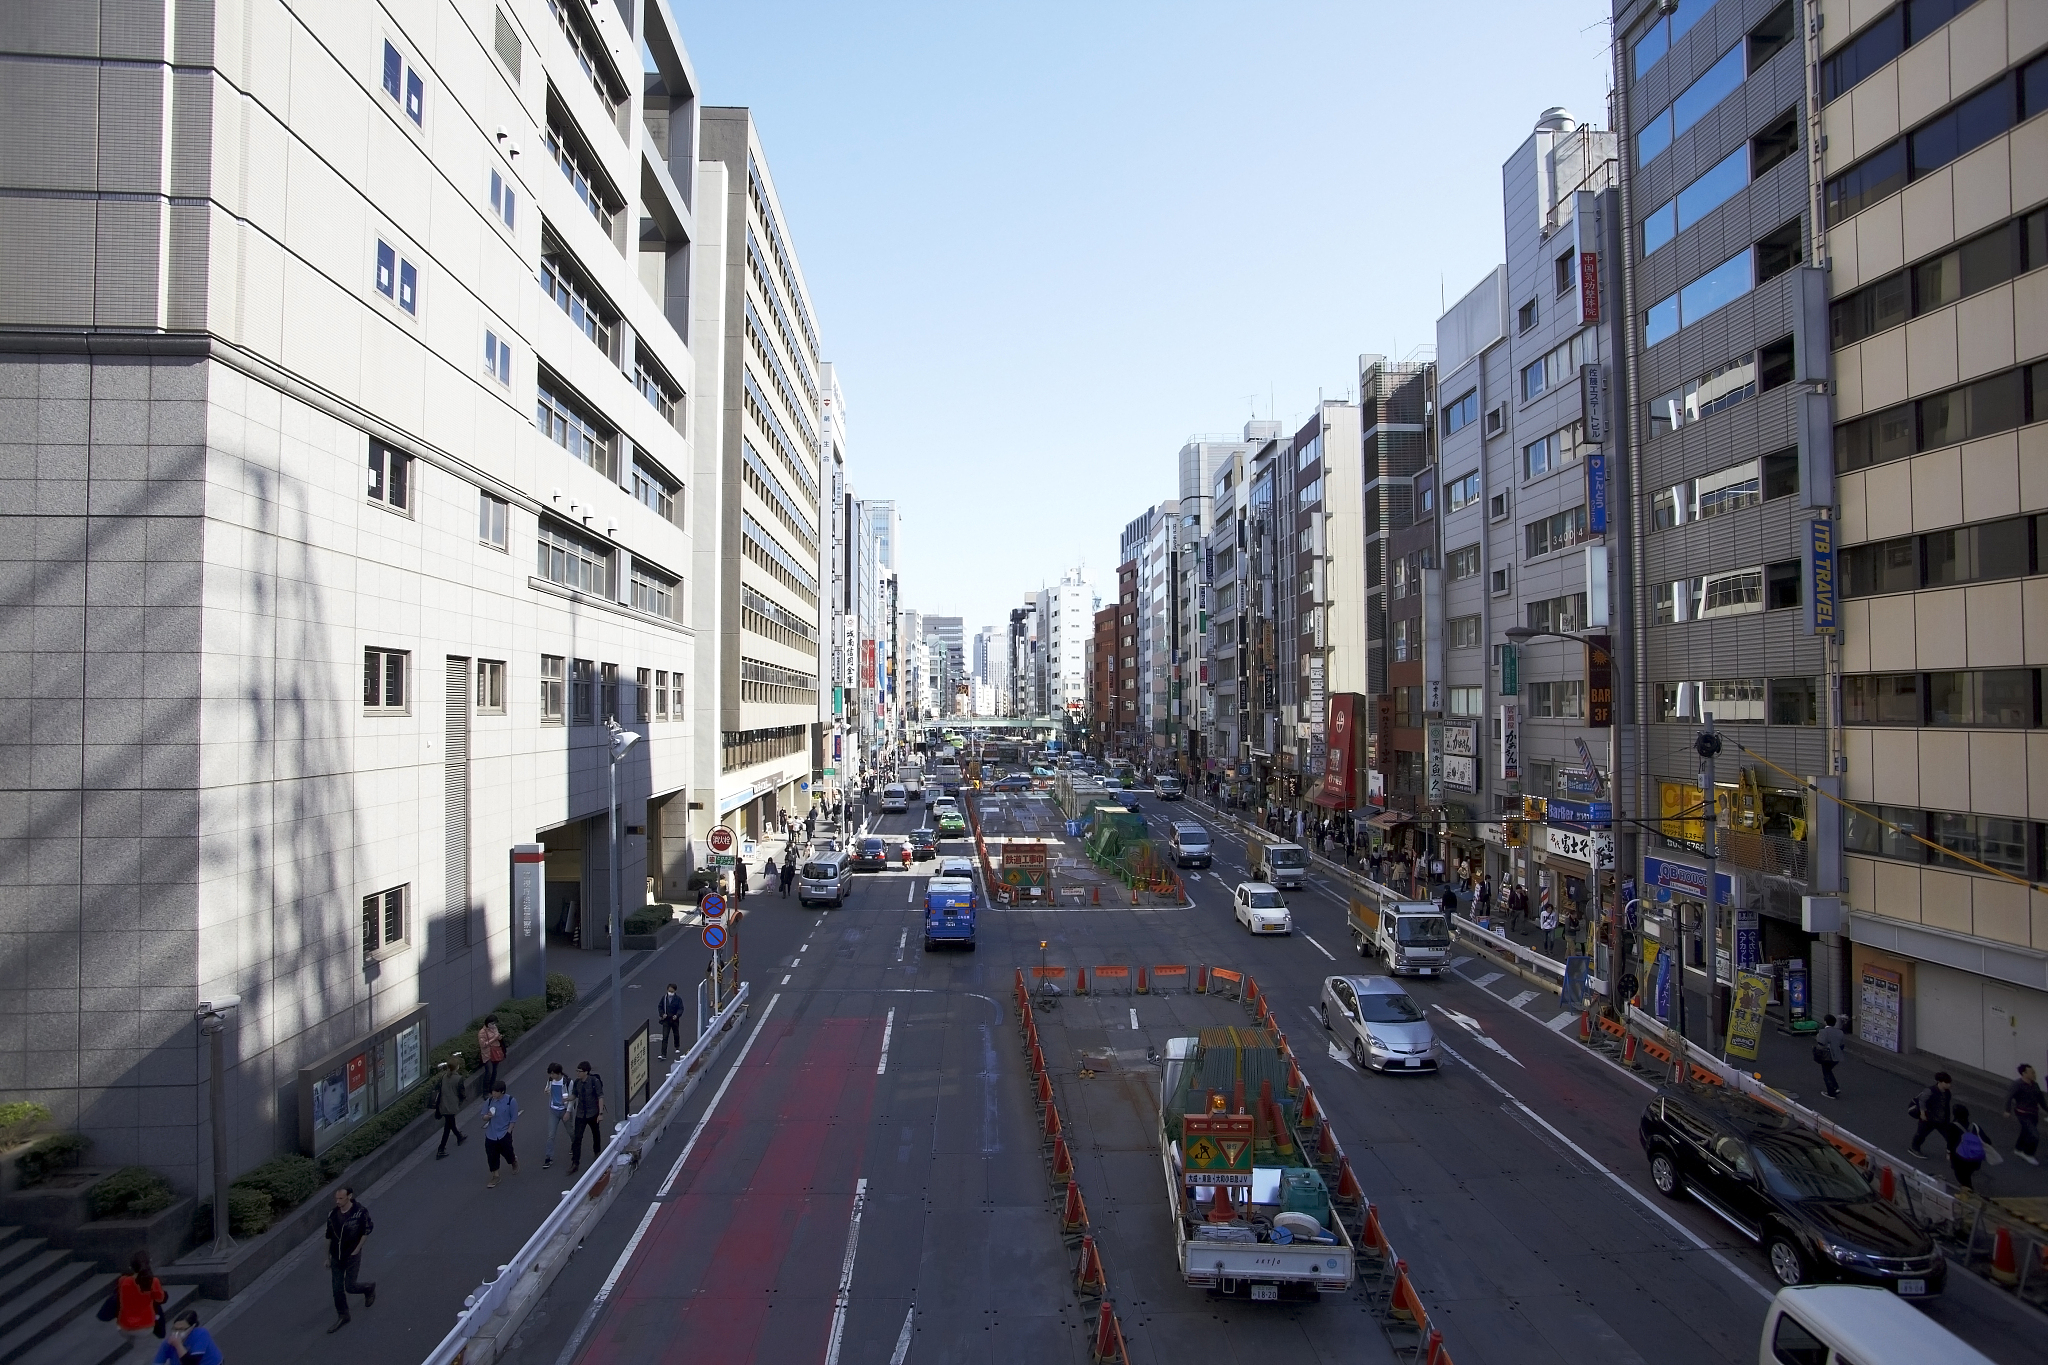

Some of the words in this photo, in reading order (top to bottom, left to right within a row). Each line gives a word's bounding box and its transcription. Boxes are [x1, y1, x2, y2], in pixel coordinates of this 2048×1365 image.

[1584, 255, 1597, 316] 中国気功整体院
[1589, 368, 1600, 438] 佐藤エステートビル
[1596, 472, 1604, 508] こんどう
[1815, 524, 1830, 553] ITB
[1816, 559, 1832, 624] TRAVEL
[1592, 688, 1611, 702] BAR
[1507, 707, 1516, 729] 居酒屋
[1595, 708, 1608, 721] 3F
[1505, 730, 1517, 763] かあさん
[1549, 803, 1574, 820] BarBer
[712, 835, 731, 845] 消火栓
[1561, 833, 1590, 858] 富士そ
[1005, 855, 1044, 865] 鉄道工事中
[1659, 863, 1678, 879] QB
